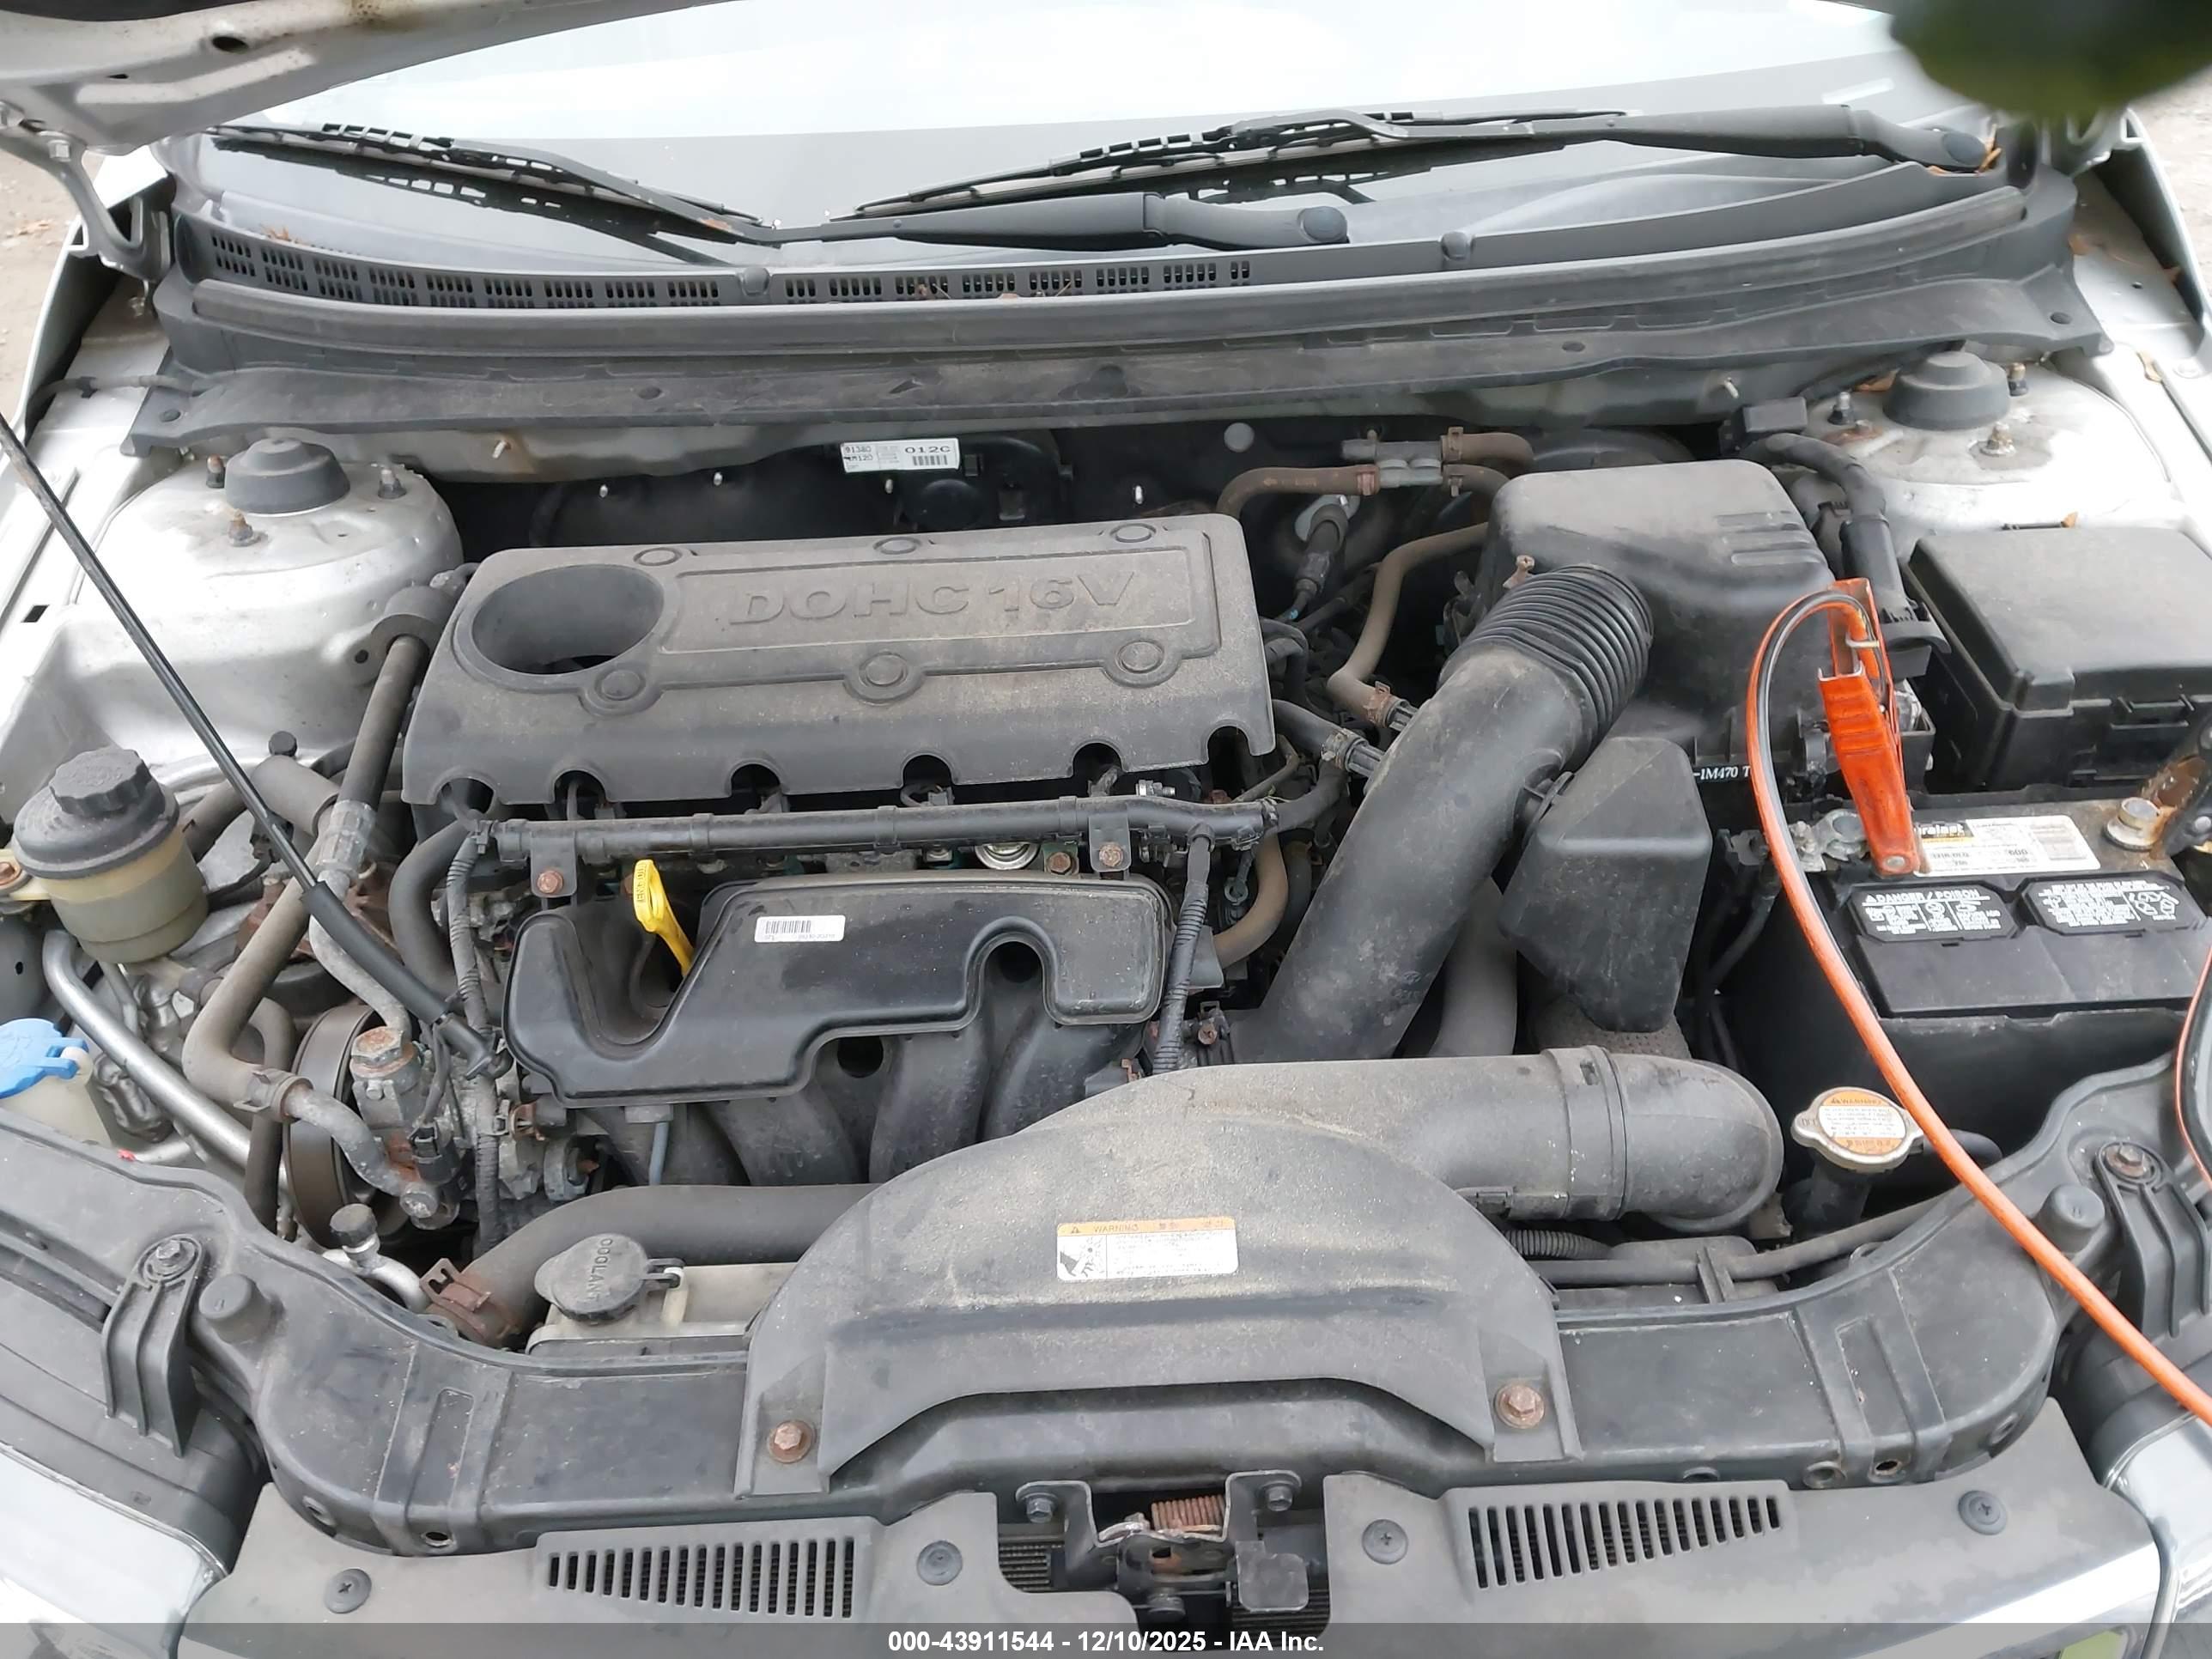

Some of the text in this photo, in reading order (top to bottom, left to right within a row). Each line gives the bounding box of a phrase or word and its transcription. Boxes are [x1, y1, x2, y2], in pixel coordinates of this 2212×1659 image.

[728, 570, 1135, 625] DOHC 16V
[1875, 891, 1925, 903] DANGER
[1936, 889, 1981, 900] POISON
